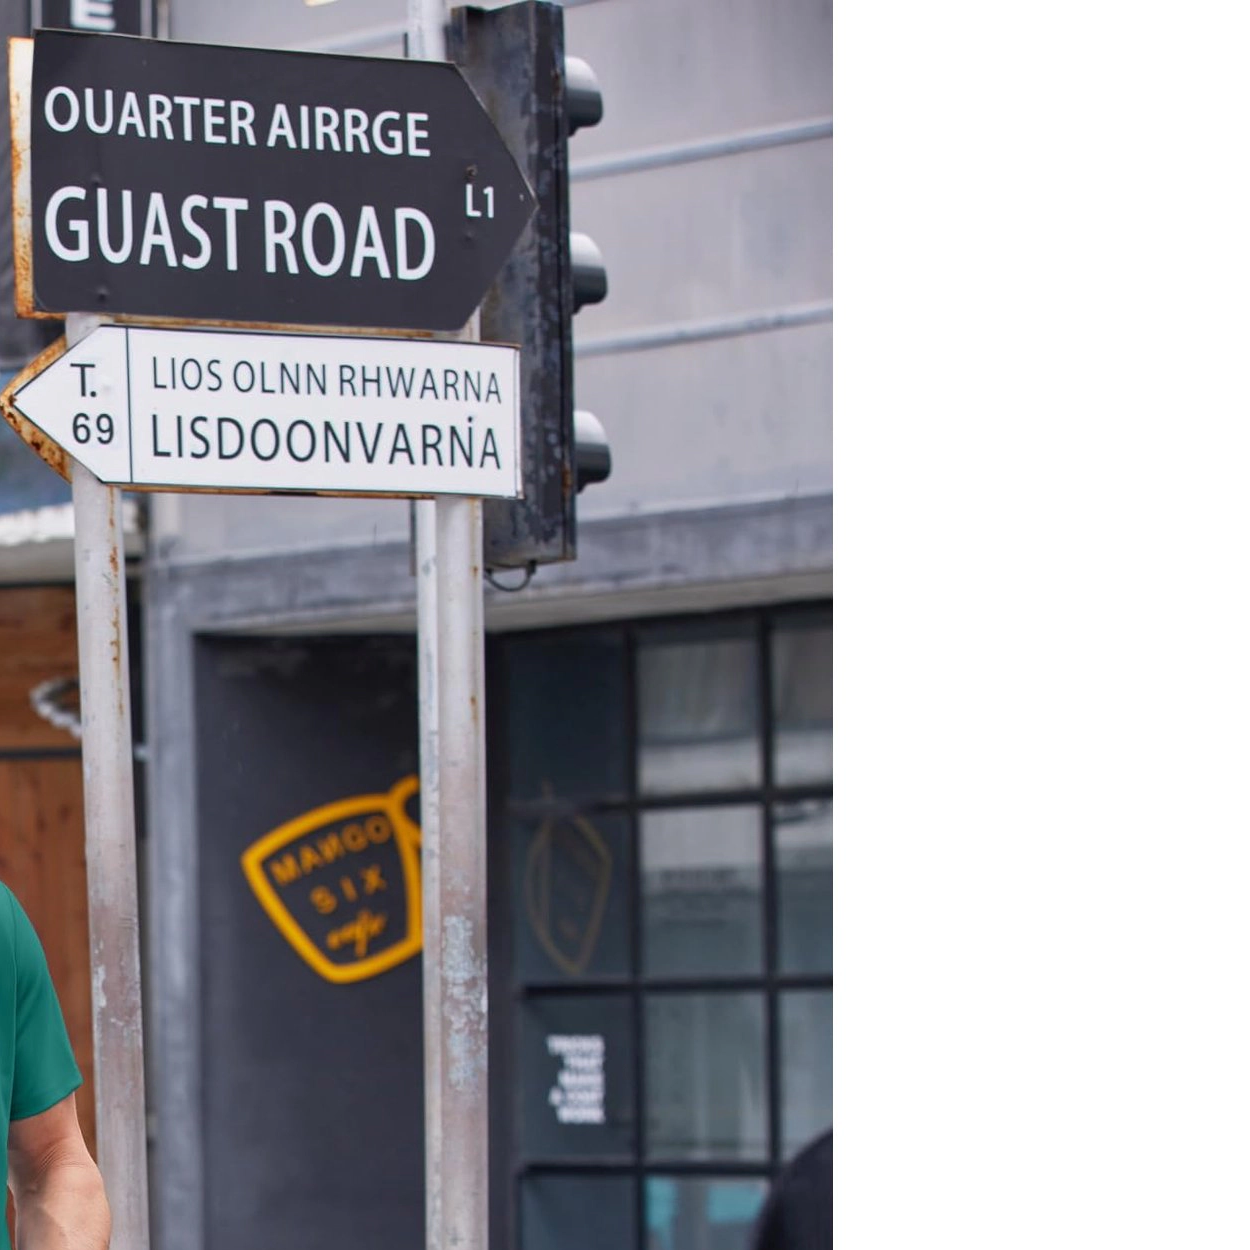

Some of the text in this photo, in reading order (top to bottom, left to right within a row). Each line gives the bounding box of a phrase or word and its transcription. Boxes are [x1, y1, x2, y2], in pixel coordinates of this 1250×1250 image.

[44, 86, 431, 157] OUARTER AIRRGE
[465, 183, 494, 219] L1
[44, 185, 436, 281] GUAST ROAD
[153, 356, 502, 405] LIOS OLNN RHWARNA
[72, 412, 114, 445] 69
[310, 864, 387, 915] SIX
